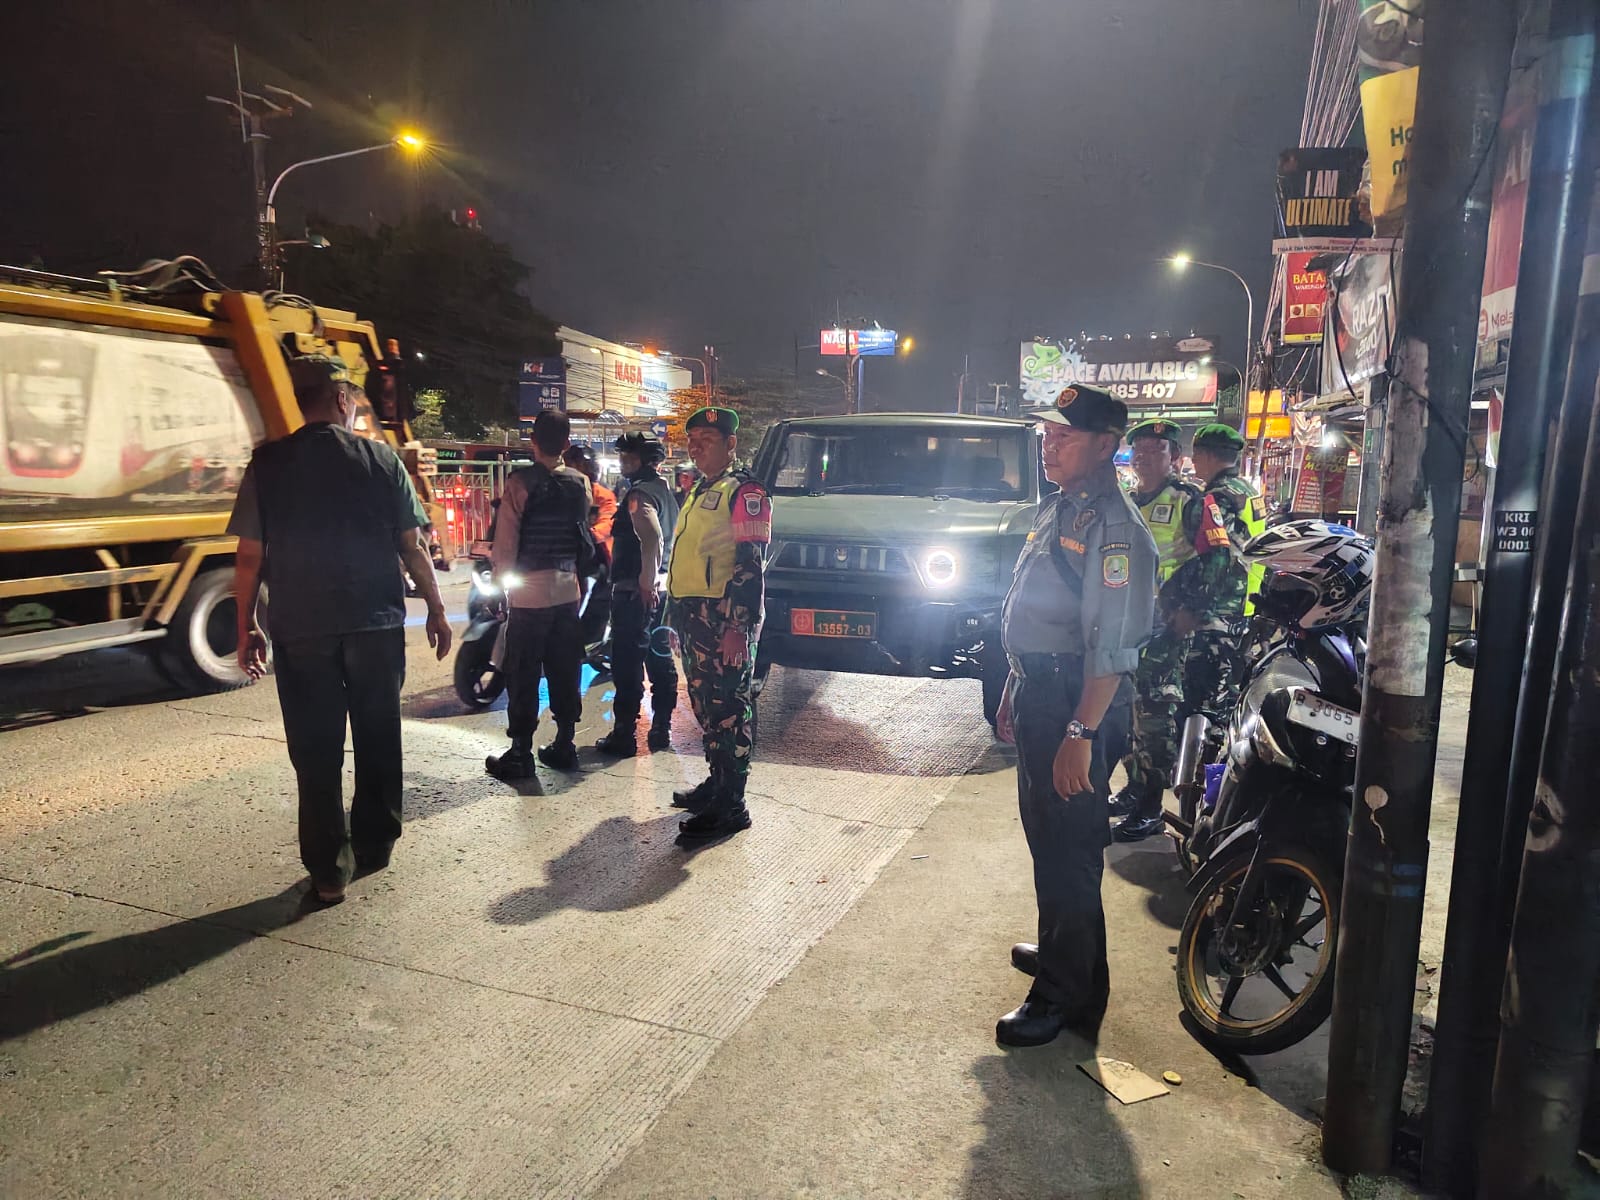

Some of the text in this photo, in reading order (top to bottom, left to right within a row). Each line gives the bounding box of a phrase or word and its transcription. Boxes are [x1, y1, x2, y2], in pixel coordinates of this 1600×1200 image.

[1304, 170, 1339, 197] I AM
[1286, 199, 1351, 226] ULTIMATE
[1098, 361, 1199, 382] AVAILABLE
[1142, 383, 1176, 398] 407
[1504, 512, 1530, 523] KRI
[1496, 526, 1517, 537] W3
[1498, 541, 1530, 551] 0001
